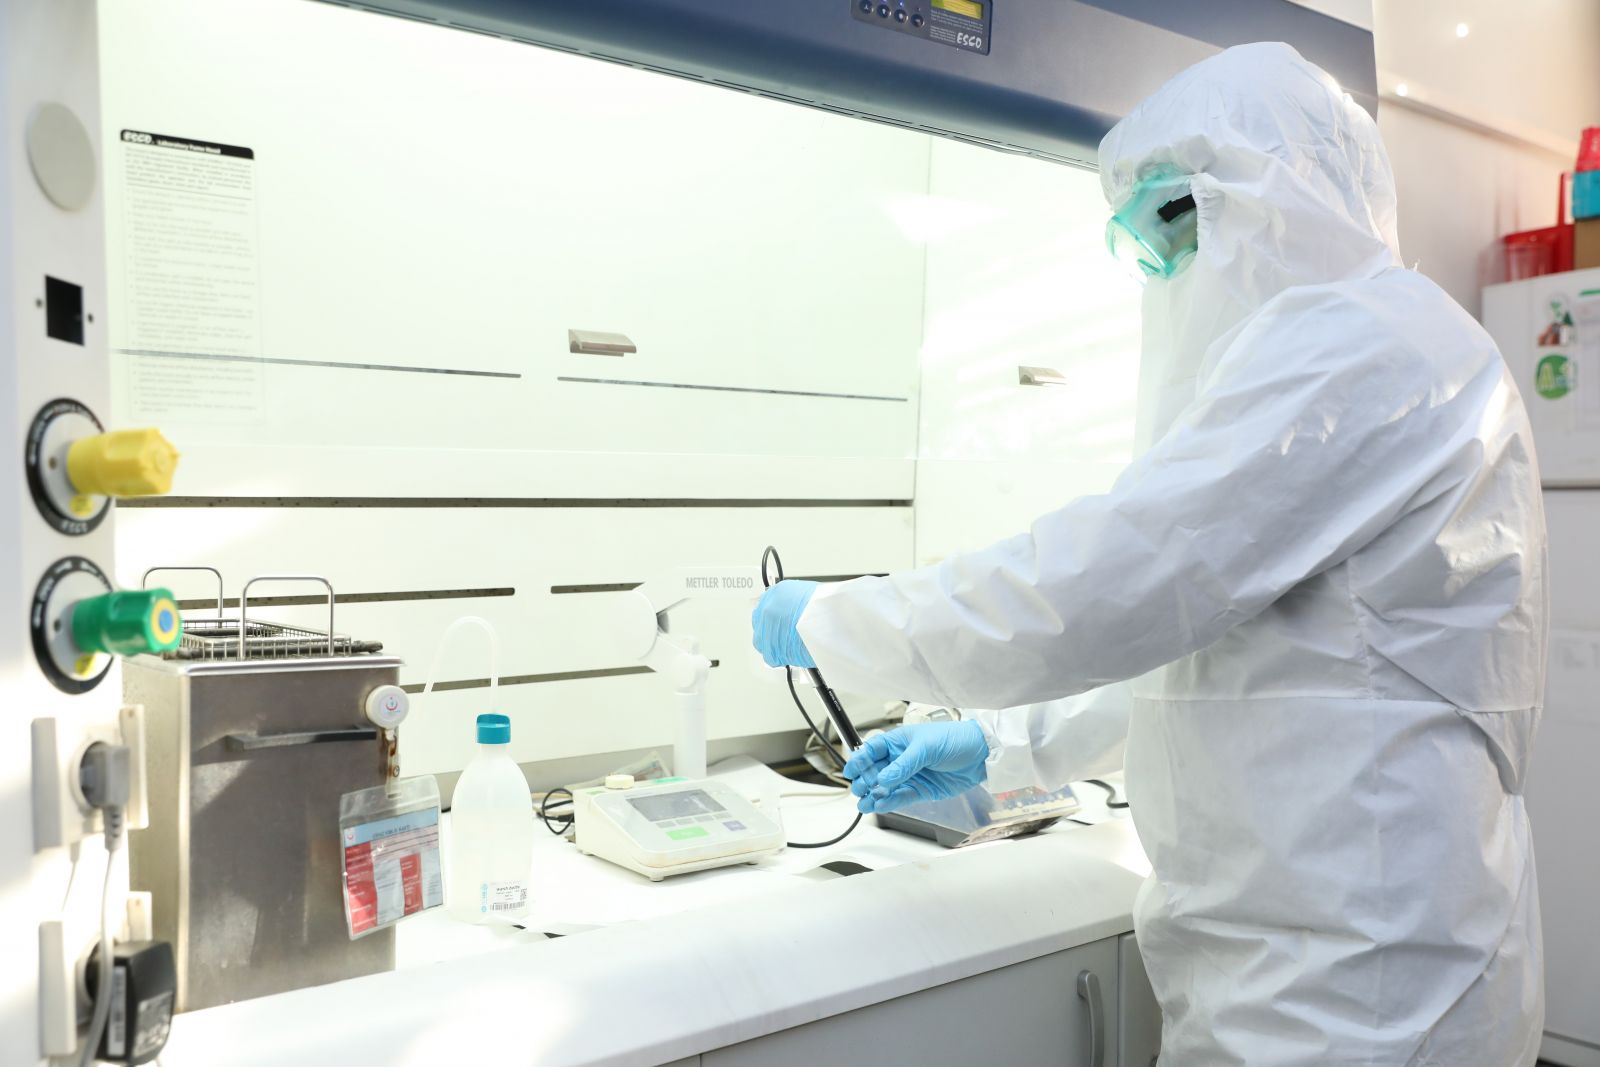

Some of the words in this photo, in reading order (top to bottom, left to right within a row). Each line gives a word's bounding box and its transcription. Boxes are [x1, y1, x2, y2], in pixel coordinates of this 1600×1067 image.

[957, 32, 981, 48] ESCO
[685, 577, 719, 588] METTLER
[722, 577, 753, 588] TOLEDO
